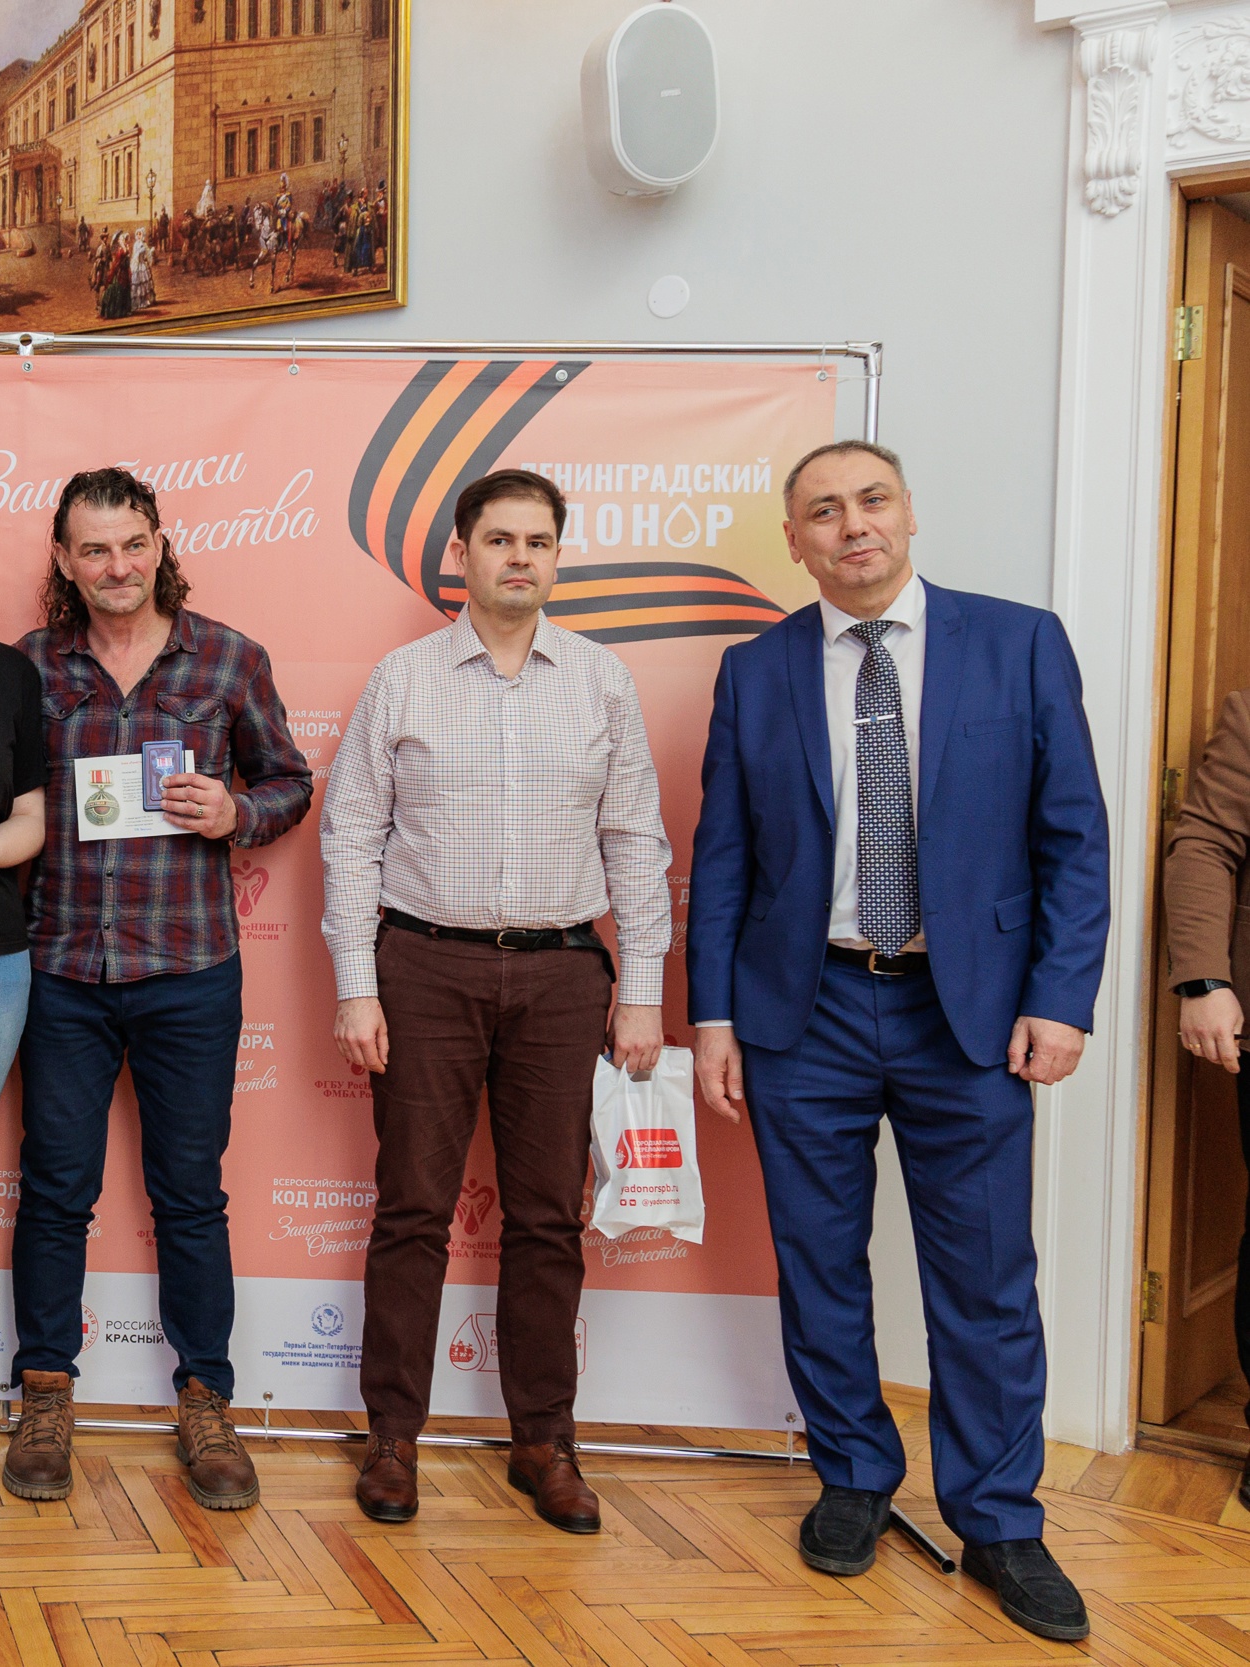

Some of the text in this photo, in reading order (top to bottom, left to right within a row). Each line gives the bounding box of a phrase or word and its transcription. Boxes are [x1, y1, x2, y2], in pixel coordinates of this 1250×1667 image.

[308, 710, 341, 719] АКЦИЯ
[240, 922, 289, 931] осНИИГТ
[246, 932, 279, 940] России
[242, 1022, 275, 1031] АКЦИЯ
[239, 1034, 275, 1050] ОРА
[314, 1080, 370, 1090] ФГБУ РосН
[323, 1089, 356, 1098] ФМБА
[273, 1177, 377, 1190] ВСЕРОССИЙСКАЯ АКЦ
[272, 1189, 376, 1209] КОД ДОНОР
[268, 1215, 369, 1241] Защитники
[307, 1233, 371, 1258] Отечест
[460, 1241, 501, 1250] РосНИИ
[473, 1250, 500, 1259] Росси
[601, 1240, 688, 1268] Отечества
[106, 1319, 164, 1332] РОССИЙС
[105, 1333, 164, 1345] КРАСНЫЙ
[283, 1341, 363, 1352] Первый Санкт-Петербургск
[262, 1350, 312, 1359] государственный
[314, 1353, 353, 1361] медицинский
[301, 1361, 334, 1369] академика
